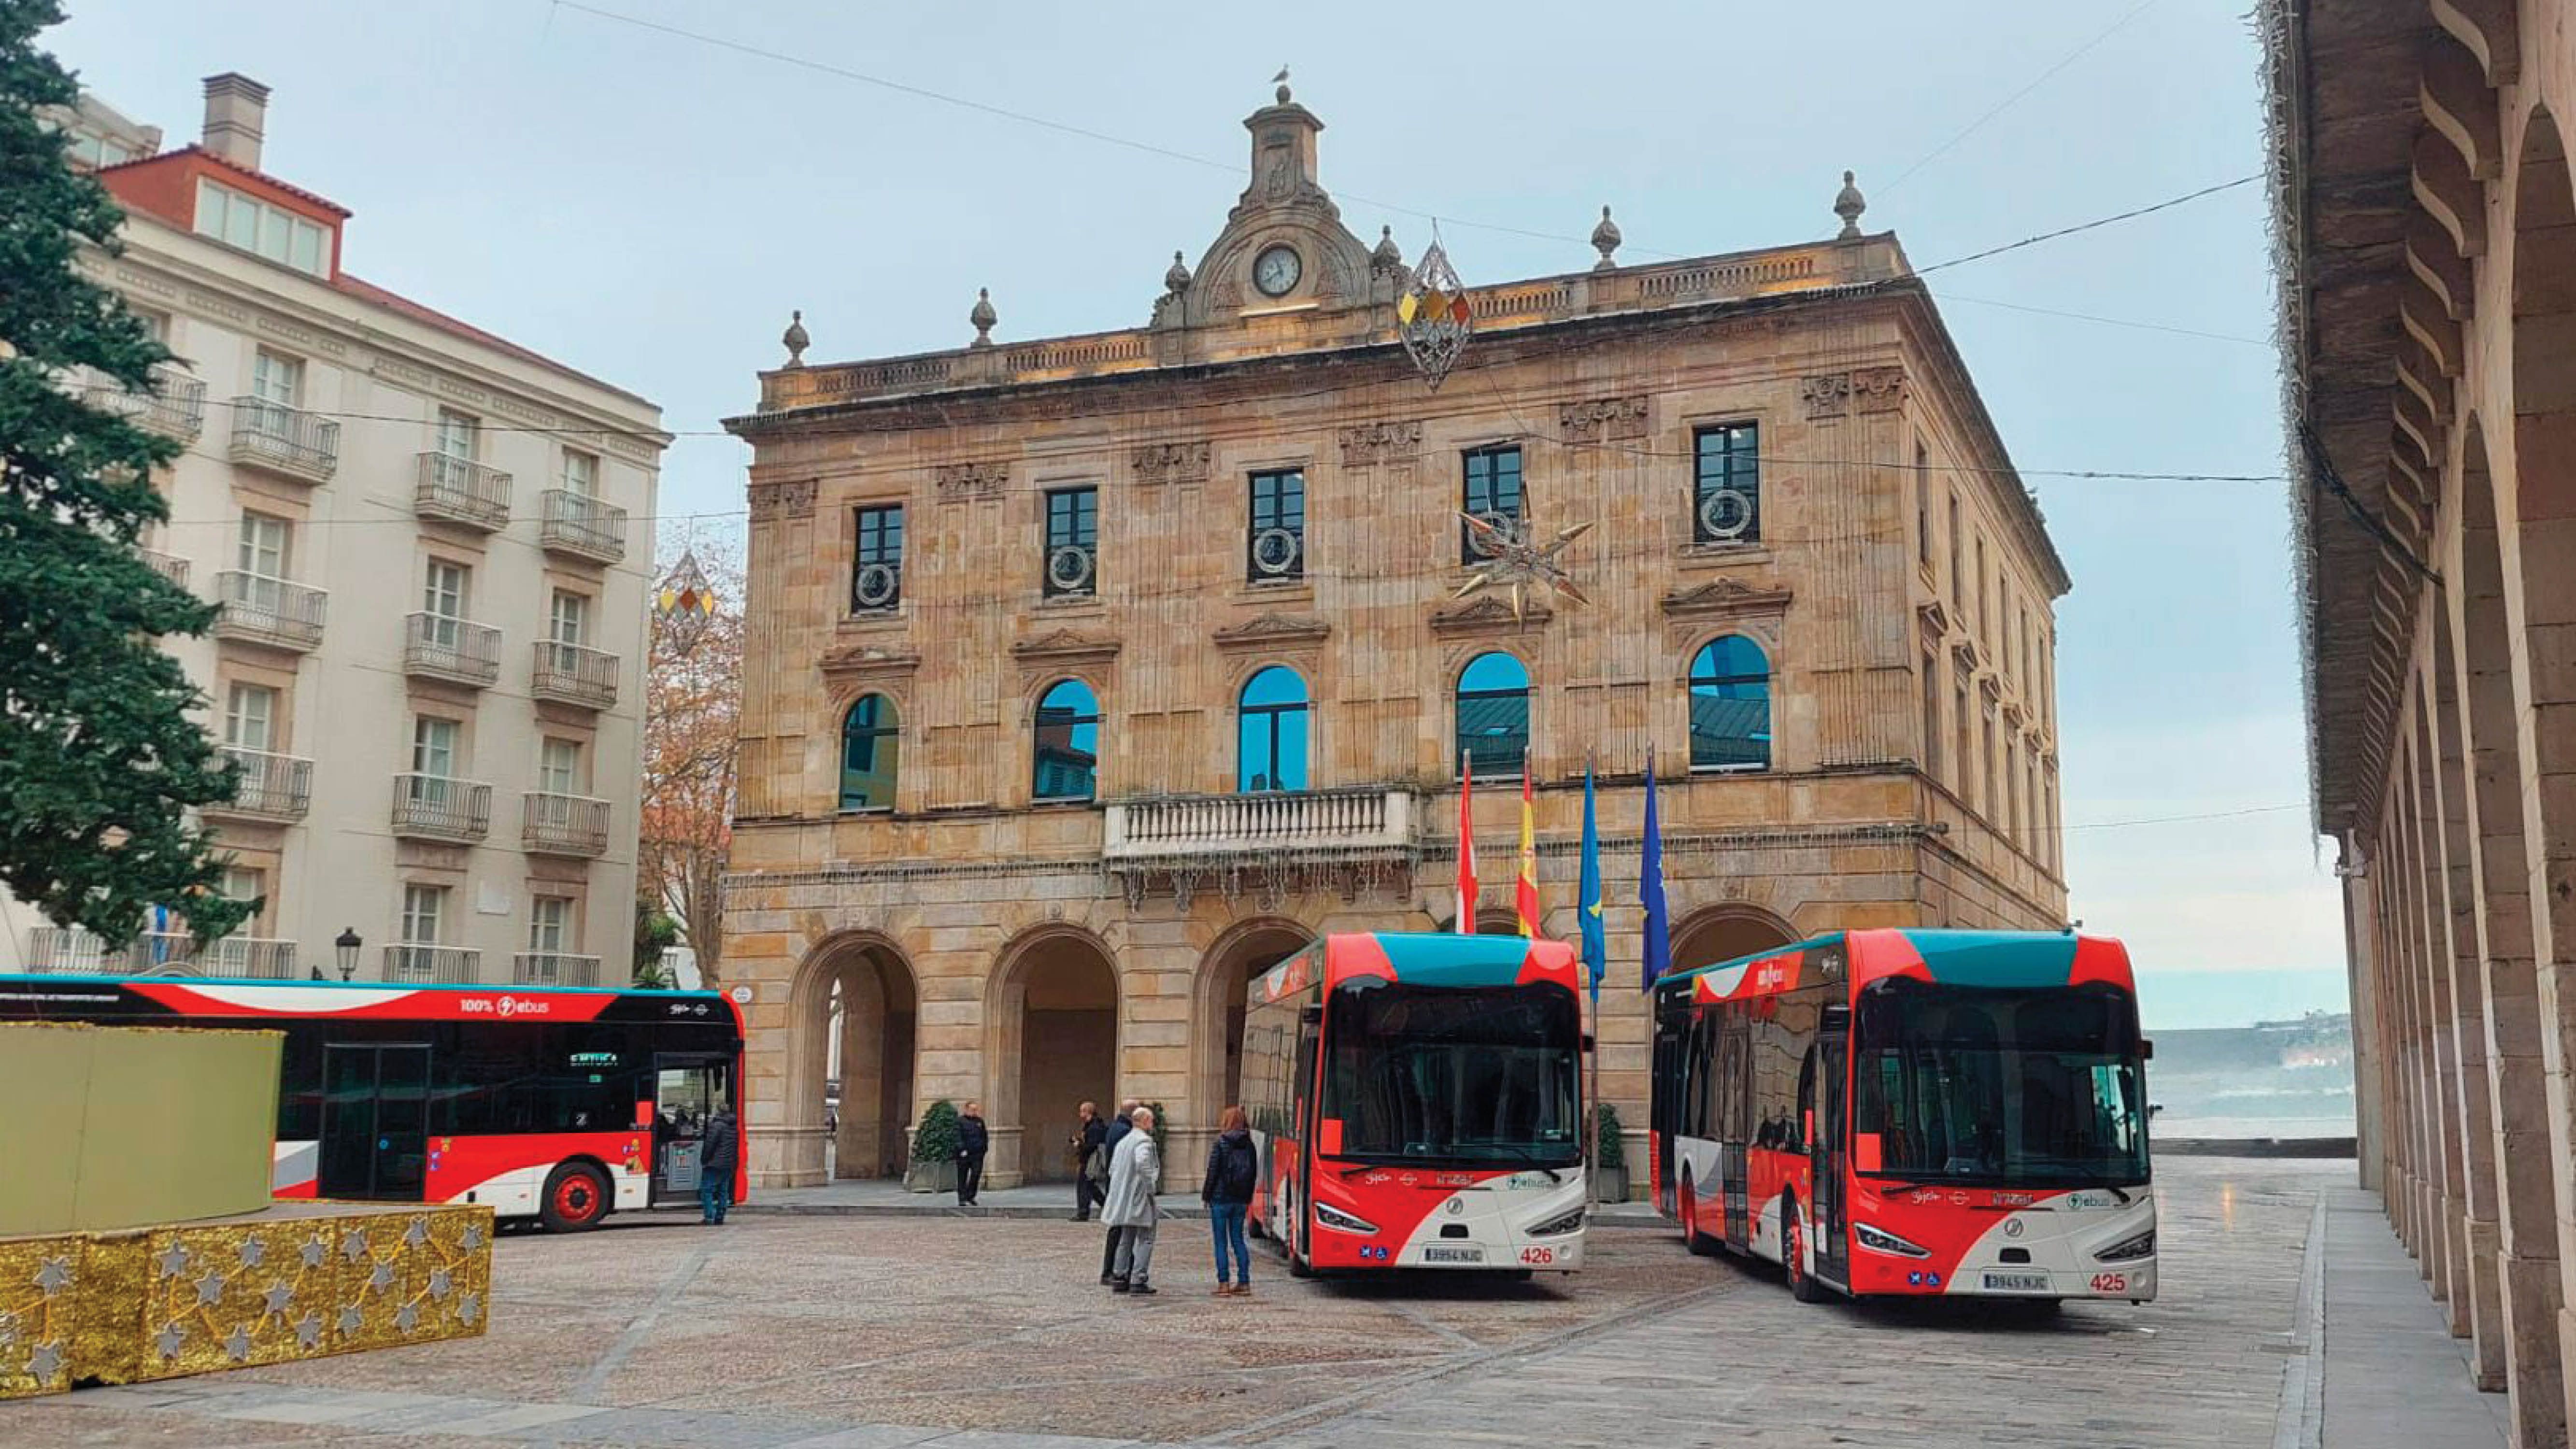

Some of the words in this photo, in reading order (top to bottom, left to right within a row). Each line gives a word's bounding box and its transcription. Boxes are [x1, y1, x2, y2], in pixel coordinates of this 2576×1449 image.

[461, 999, 494, 1012] 100%
[517, 998, 550, 1013] ebus
[1520, 1247, 1553, 1264] 426
[2090, 1274, 2125, 1291] 425
